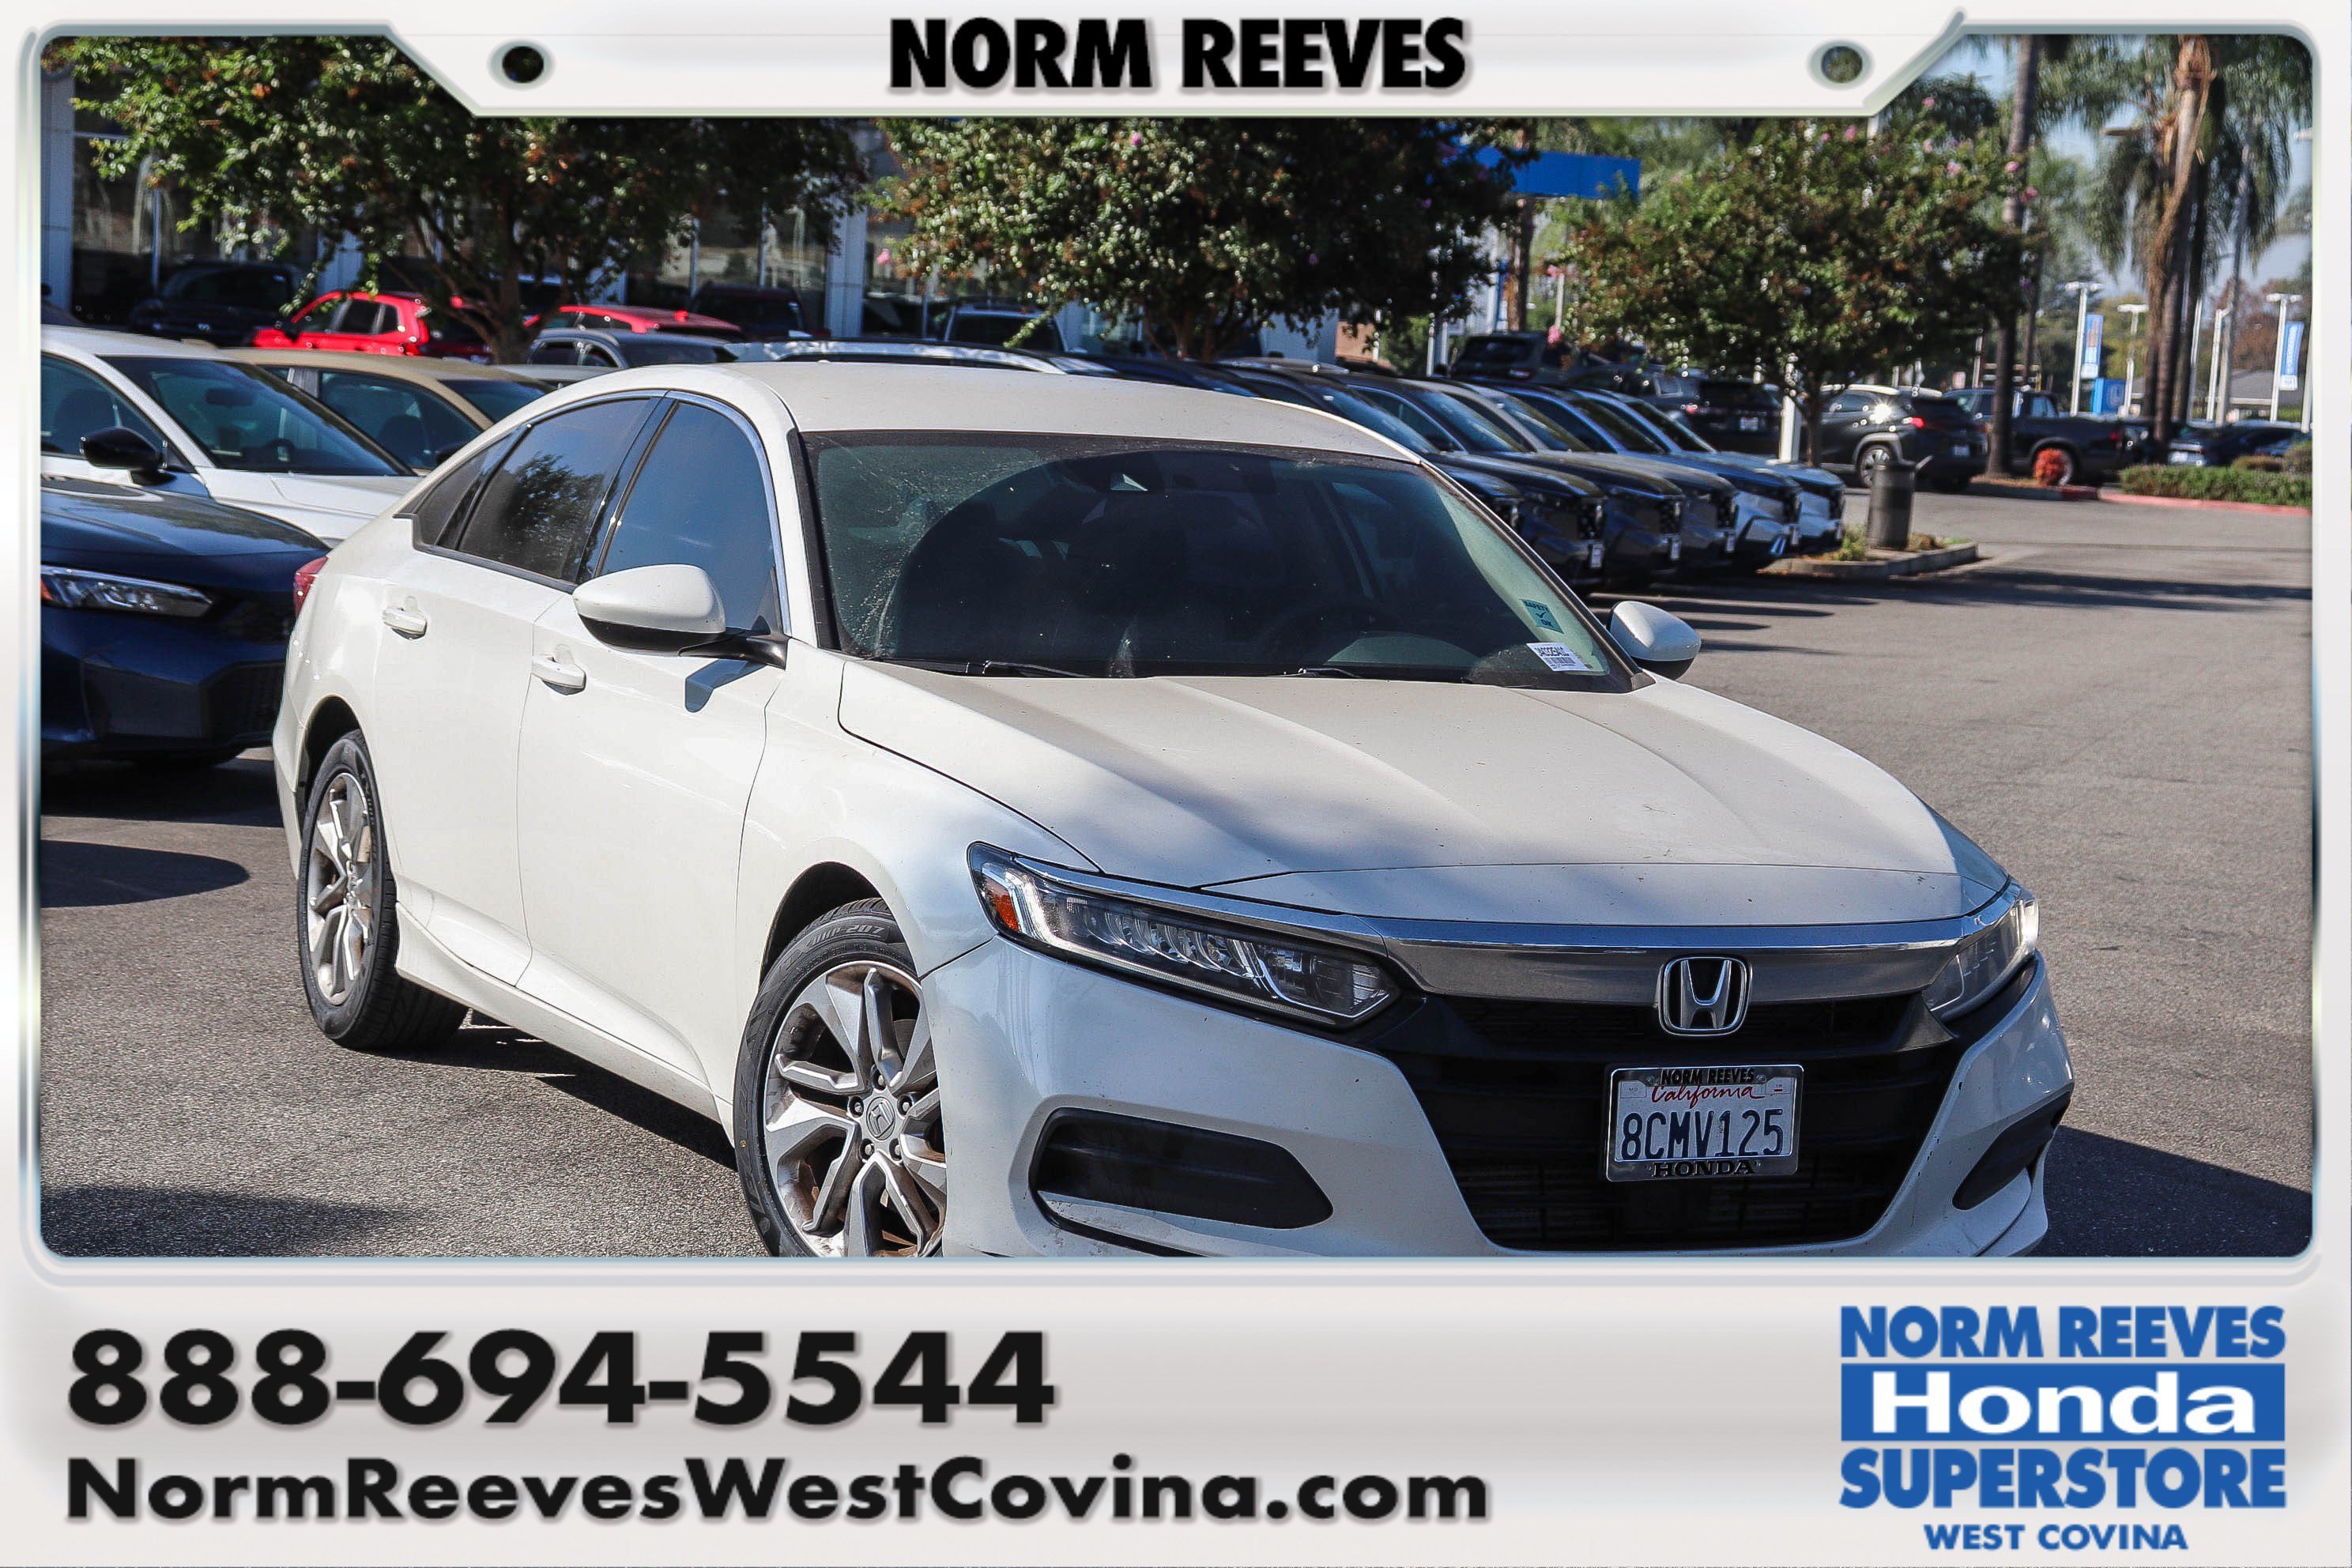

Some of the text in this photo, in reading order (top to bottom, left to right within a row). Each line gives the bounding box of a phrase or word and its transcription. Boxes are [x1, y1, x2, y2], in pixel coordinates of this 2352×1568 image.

[1660, 1068, 1755, 1085] NORM REEVES
[1651, 1085, 1766, 1109] California
[1621, 1108, 1784, 1160] 8CMV125
[1653, 1159, 1755, 1177] HONDA
